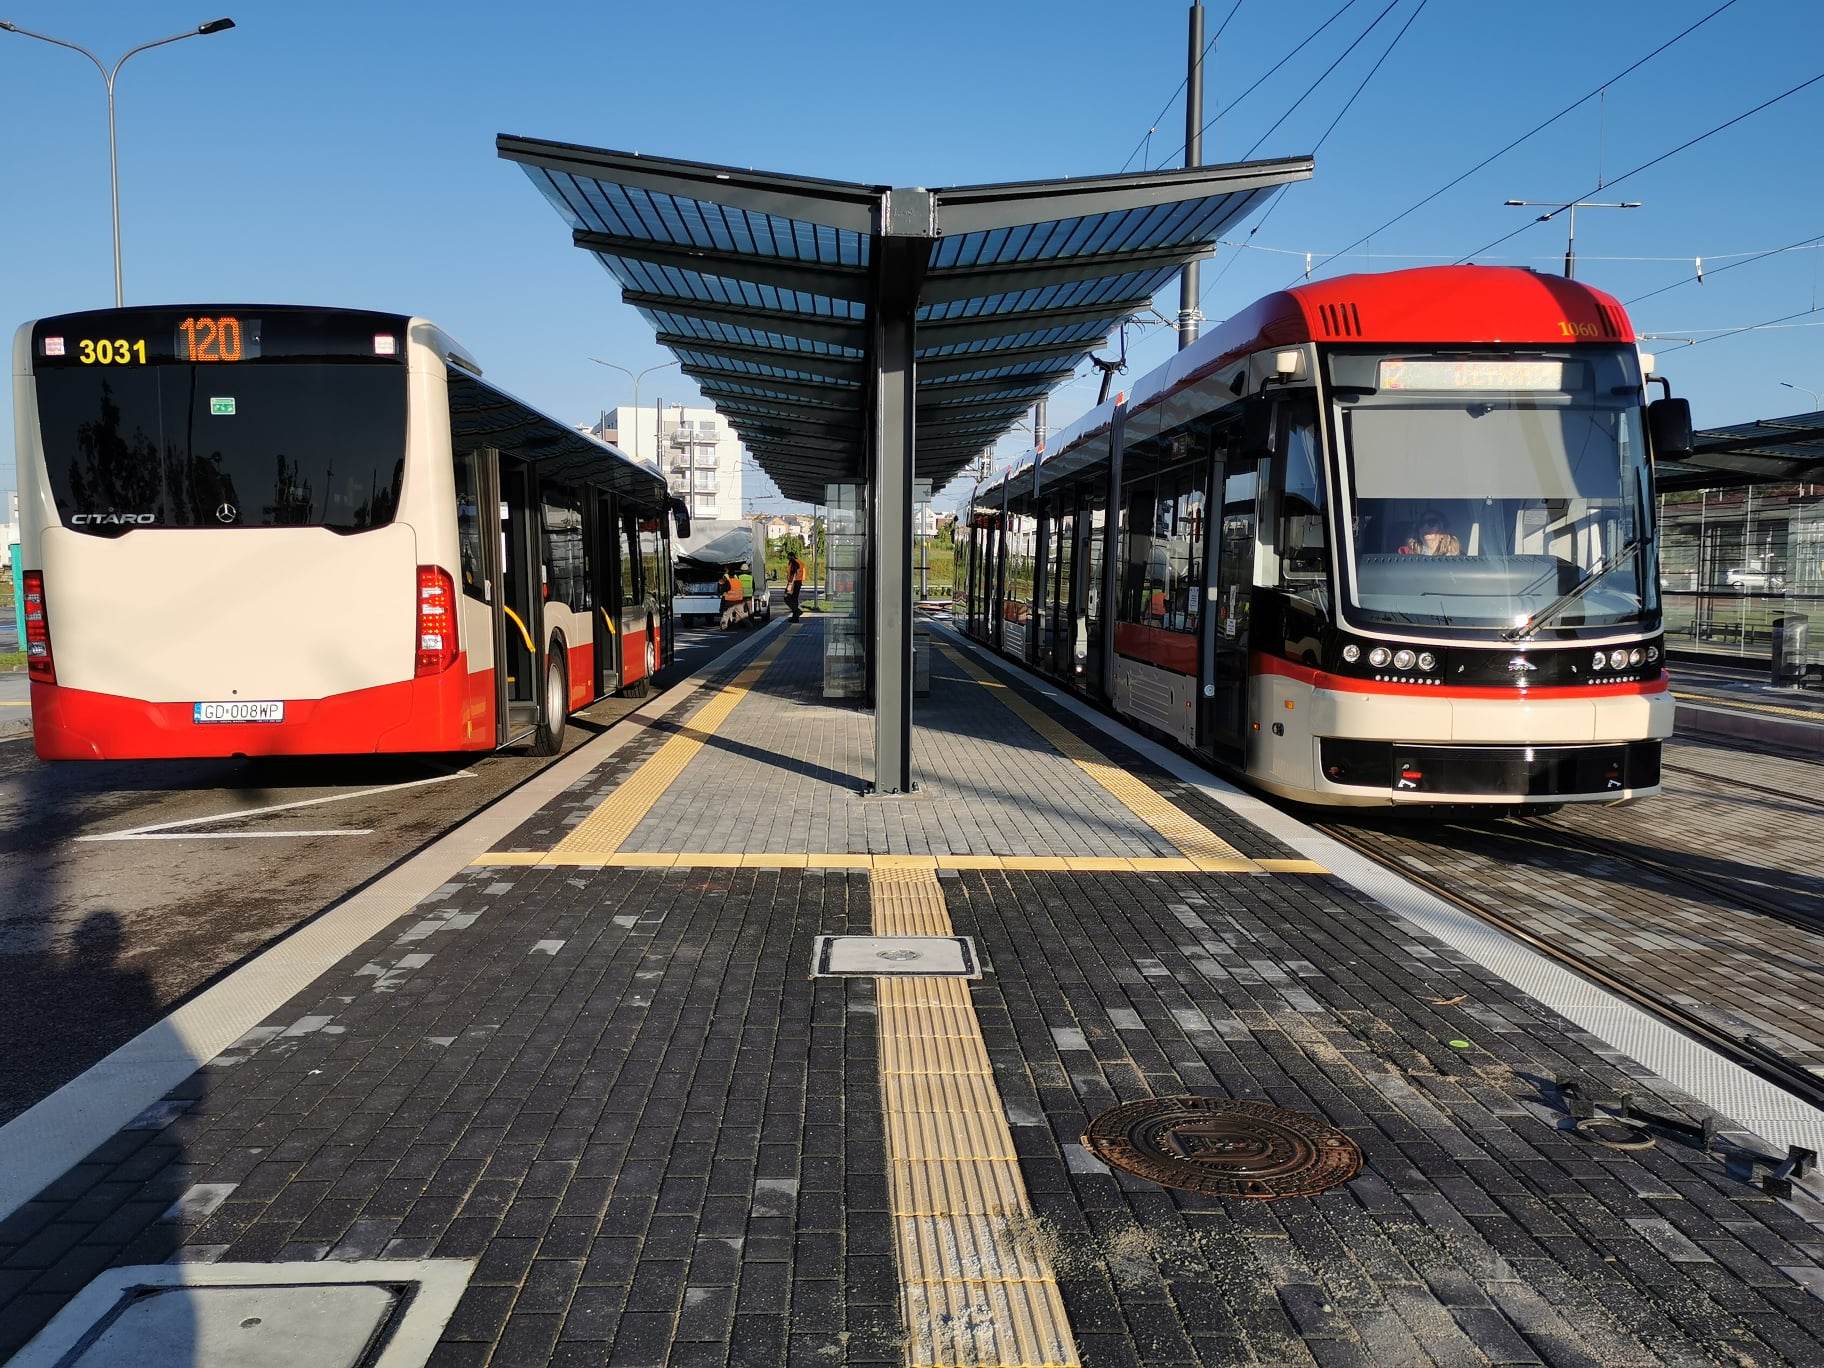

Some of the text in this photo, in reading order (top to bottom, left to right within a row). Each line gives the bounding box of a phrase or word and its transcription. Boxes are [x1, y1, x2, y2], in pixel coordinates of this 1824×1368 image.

[1558, 321, 1598, 337] 1060
[179, 317, 240, 361] 120
[79, 339, 146, 364] 3031
[71, 513, 155, 524] CITARO
[205, 704, 225, 718] GD
[230, 703, 279, 718] 008WP
